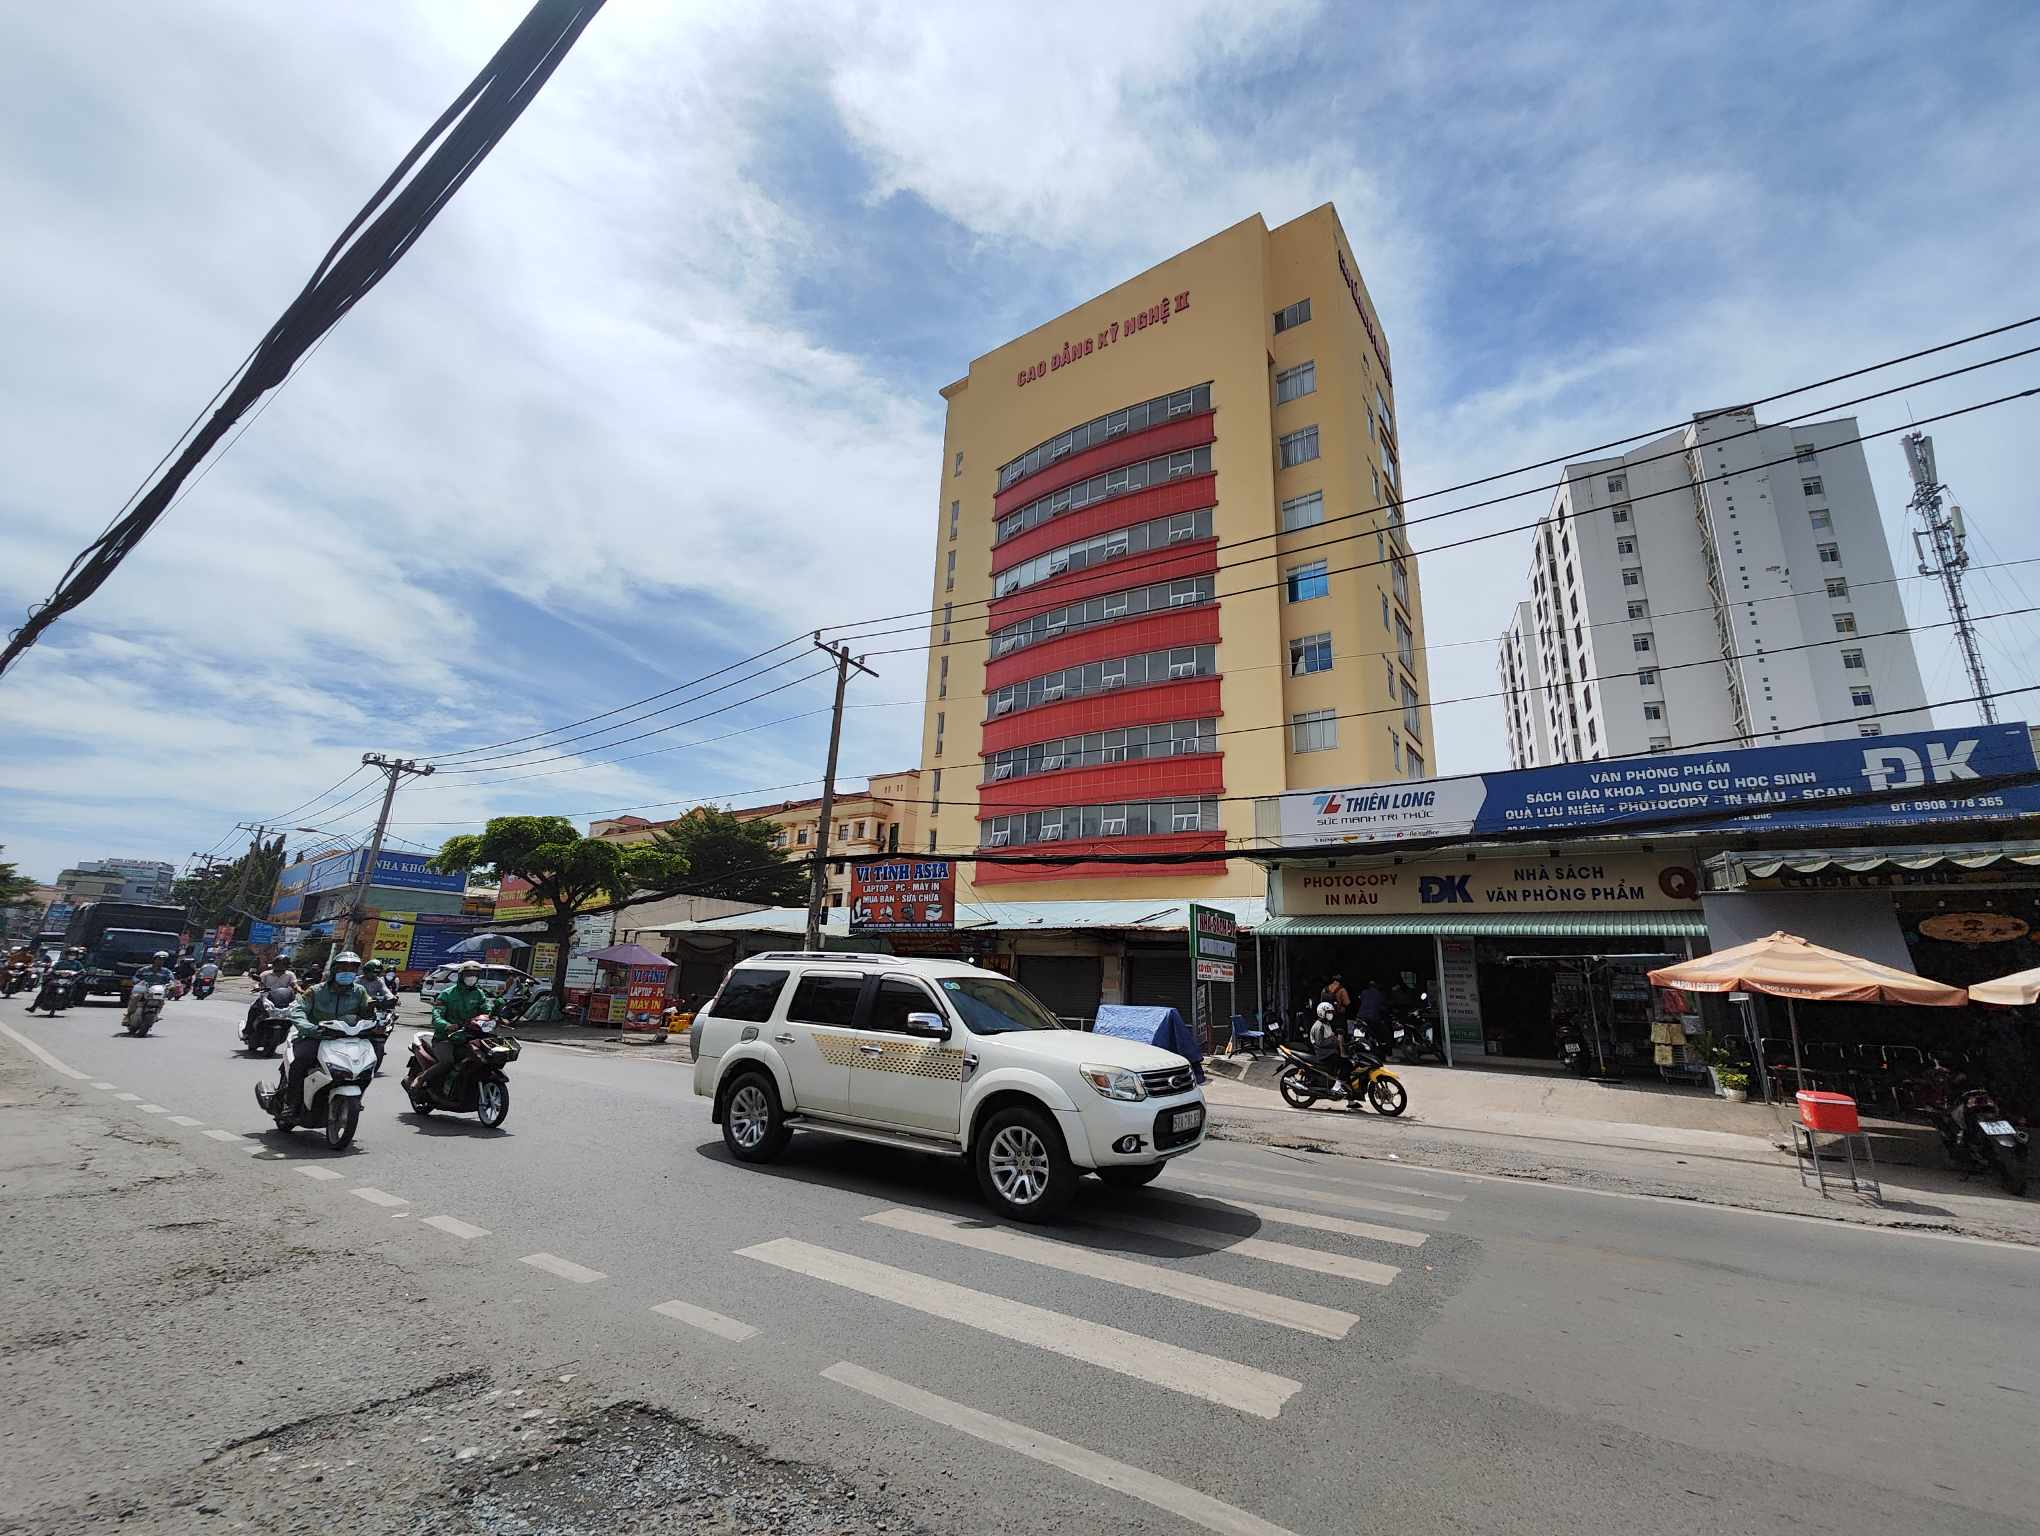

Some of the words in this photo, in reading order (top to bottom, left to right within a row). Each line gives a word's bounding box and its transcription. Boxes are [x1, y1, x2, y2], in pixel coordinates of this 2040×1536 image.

[1017, 360, 1047, 387] CAO
[1051, 338, 1094, 371] ĐẲNG
[1097, 321, 1120, 350] KỸ
[1124, 298, 1170, 337] NGHỆ
[1590, 771, 1622, 784] VĂN
[1626, 766, 1679, 782] PHÒNG
[1684, 760, 1731, 776] PHẨM
[1861, 740, 1982, 791] ĐK
[1526, 790, 1563, 804] SÁCH
[1566, 788, 1600, 801] GIÁO
[1604, 785, 1645, 798] KHOA
[1658, 780, 1703, 796] DỤNG
[1708, 779, 1729, 792] CỤ
[1735, 776, 1769, 790] HỌC
[1774, 772, 1817, 785] SINH
[1346, 793, 1390, 812] THIÊN
[1392, 791, 1435, 809] LONG
[1505, 806, 1534, 820] QUÀ
[1536, 804, 1563, 818] LƯU
[1568, 802, 1605, 816] NIỆM
[1618, 796, 1709, 813] PHOTOCOPY
[1725, 793, 1742, 805] IN
[1747, 790, 1787, 804] MÀU
[1802, 787, 1852, 800] SCAN
[1915, 799, 1947, 811] 0908
[1951, 798, 1975, 809] 778
[1979, 796, 2004, 807] 365
[1316, 815, 1339, 826] SỨC
[1402, 808, 1434, 819] THỨC
[400, 862, 433, 875] KHOA
[855, 867, 871, 882] VI
[874, 862, 911, 881] TÍNH
[913, 863, 949, 880] ASIA
[1513, 865, 1550, 881] NHÀ
[1555, 864, 1605, 880] SÁCH
[863, 884, 889, 893] LAPTOP
[895, 883, 906, 892] PC
[931, 882, 940, 891] IN
[1303, 874, 1398, 888] PHOTOCOPY
[1418, 874, 1475, 904] ĐK
[1486, 887, 1518, 903] VĂN
[1521, 885, 1586, 901] PHÒNG
[1592, 878, 1644, 900] PHẨM
[863, 895, 878, 904] MUA
[880, 894, 895, 903] BÁN
[918, 893, 939, 902] CHỮA
[1325, 894, 1341, 905] IN
[1344, 890, 1378, 905] MÀU
